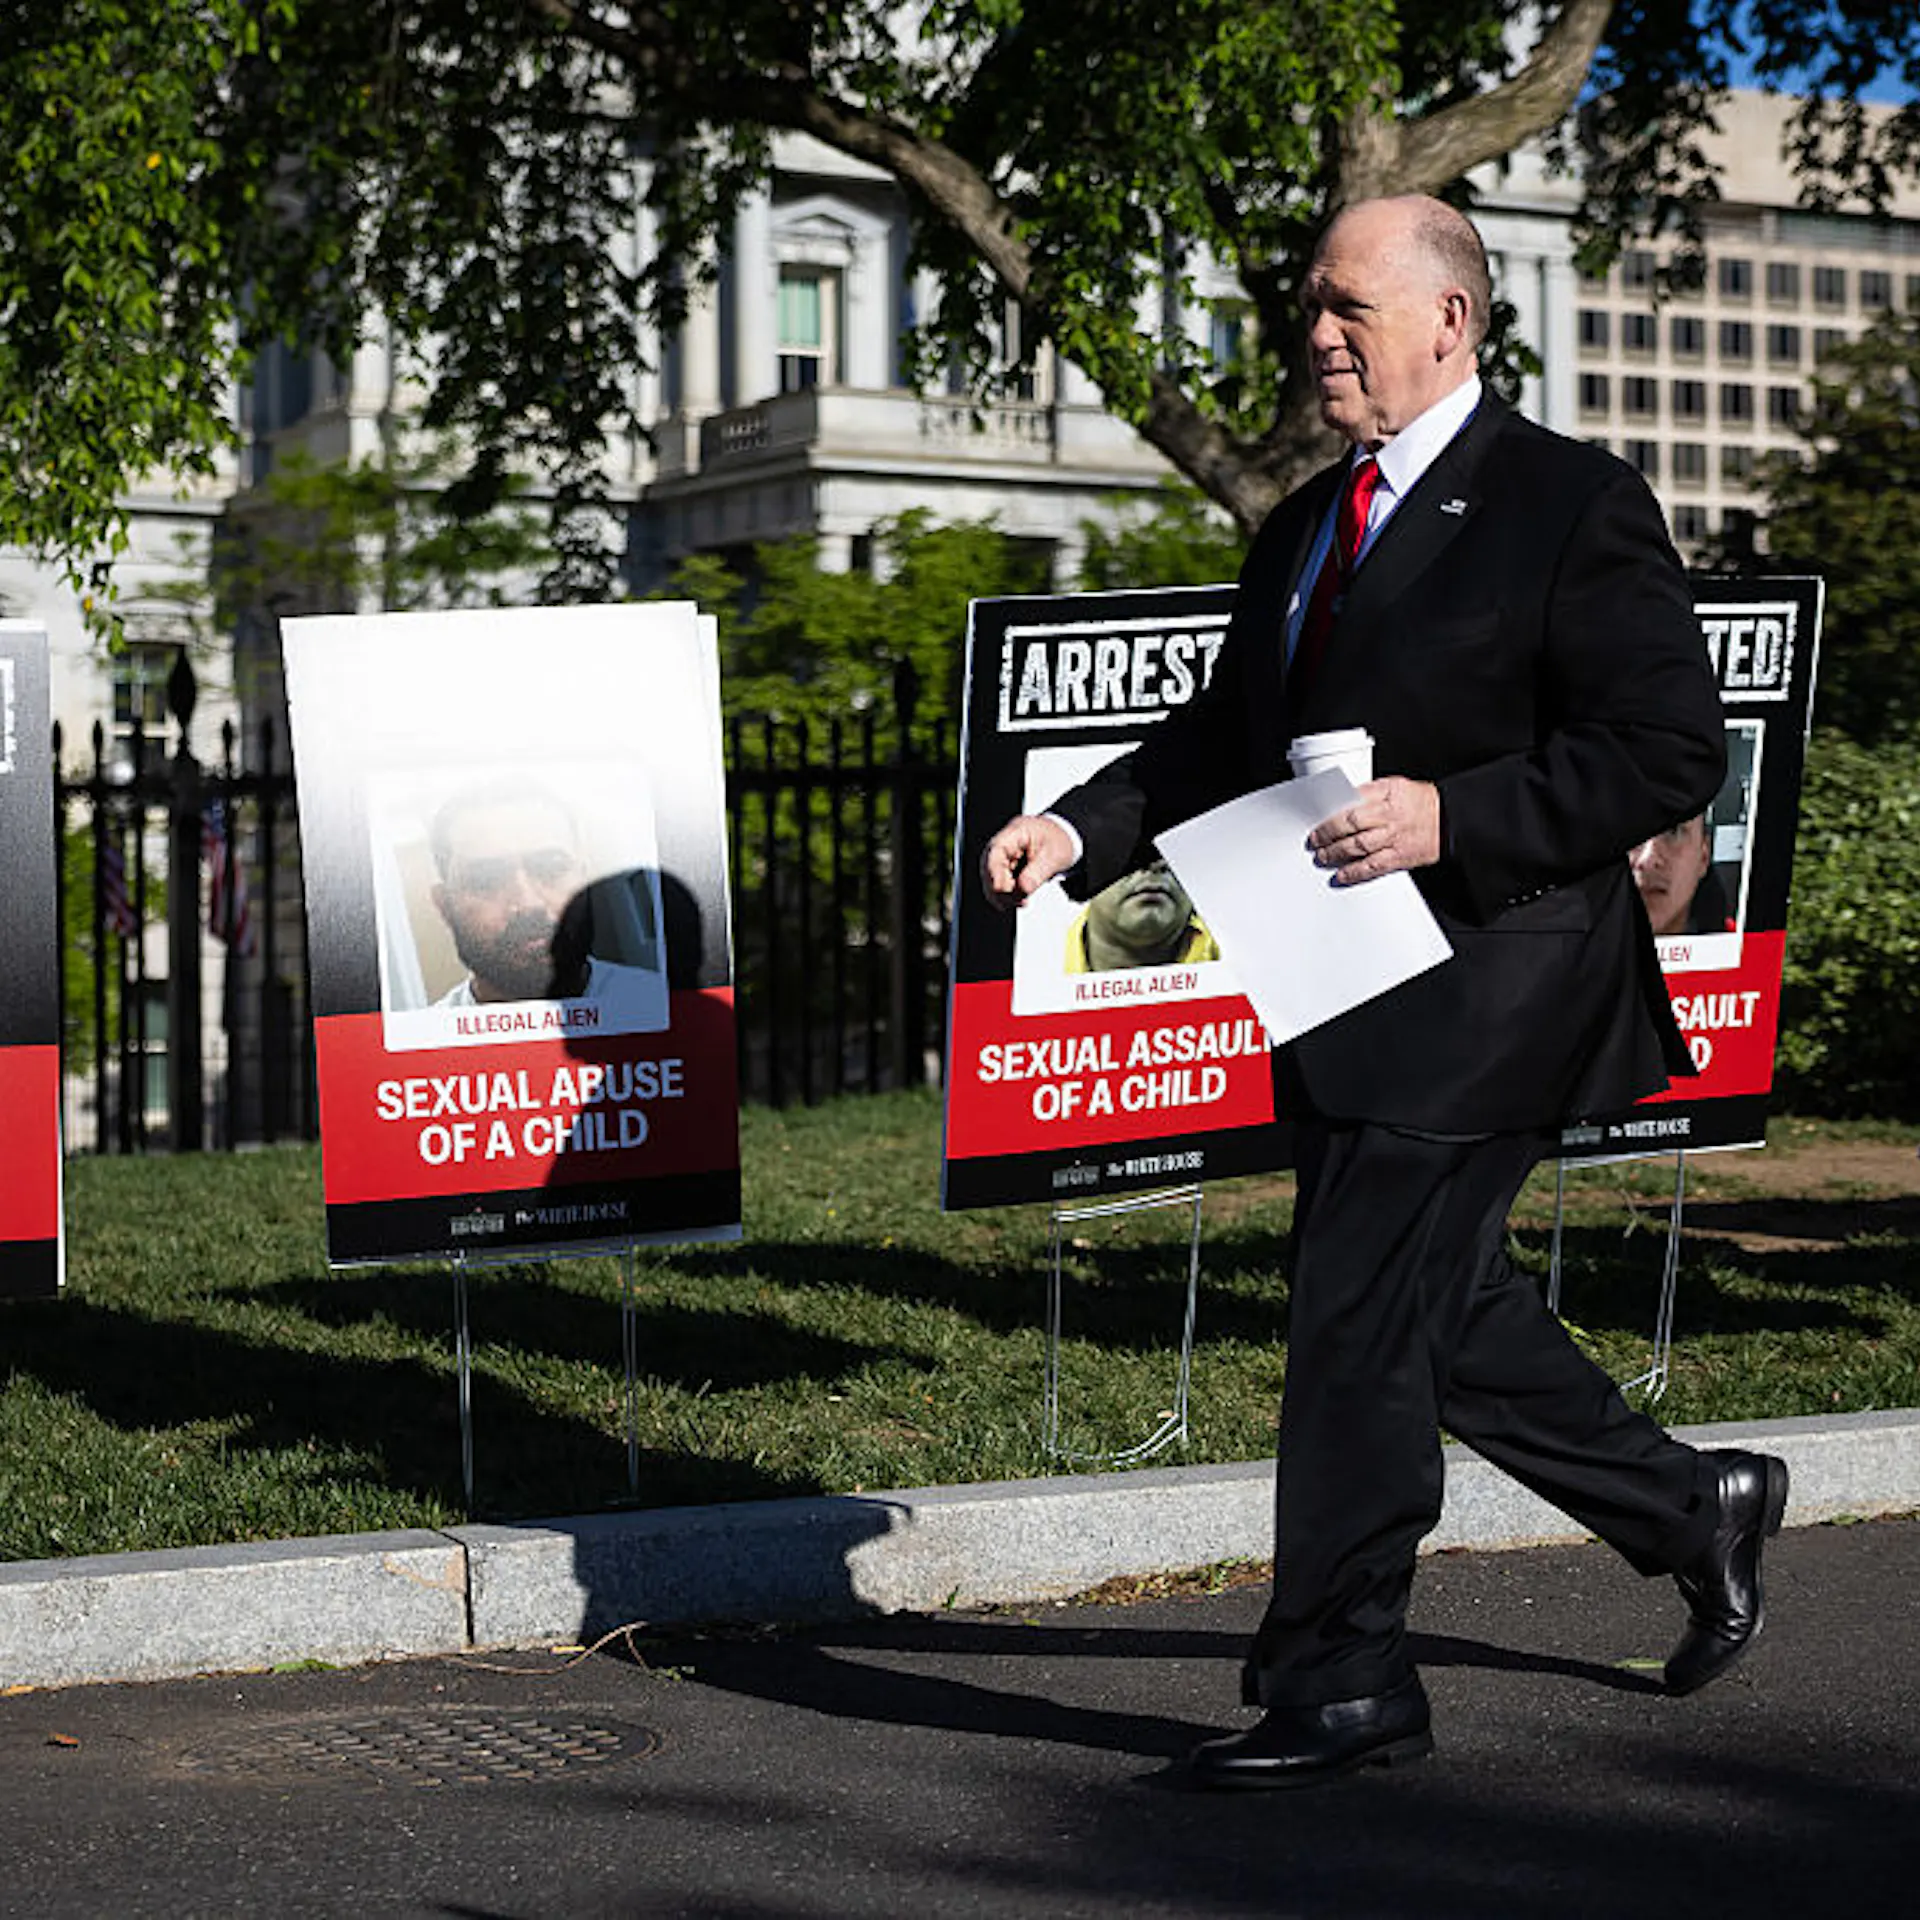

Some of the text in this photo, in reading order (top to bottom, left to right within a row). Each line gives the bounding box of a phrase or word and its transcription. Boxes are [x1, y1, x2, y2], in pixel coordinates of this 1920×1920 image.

[1015, 631, 1226, 715] ARREST
[1660, 943, 1692, 962] LIEN
[1076, 972, 1198, 1001] ILLEGAL ALIEN
[1671, 991, 1761, 1030] SAULT
[456, 1006, 598, 1035] ILLEGAL ALIEN
[978, 1033, 1120, 1083] SEXUAL
[377, 1058, 684, 1120] SEXUAL ABUSE
[1032, 1066, 1227, 1121] OF A CHILD
[419, 1108, 649, 1165] OF A CHILD
